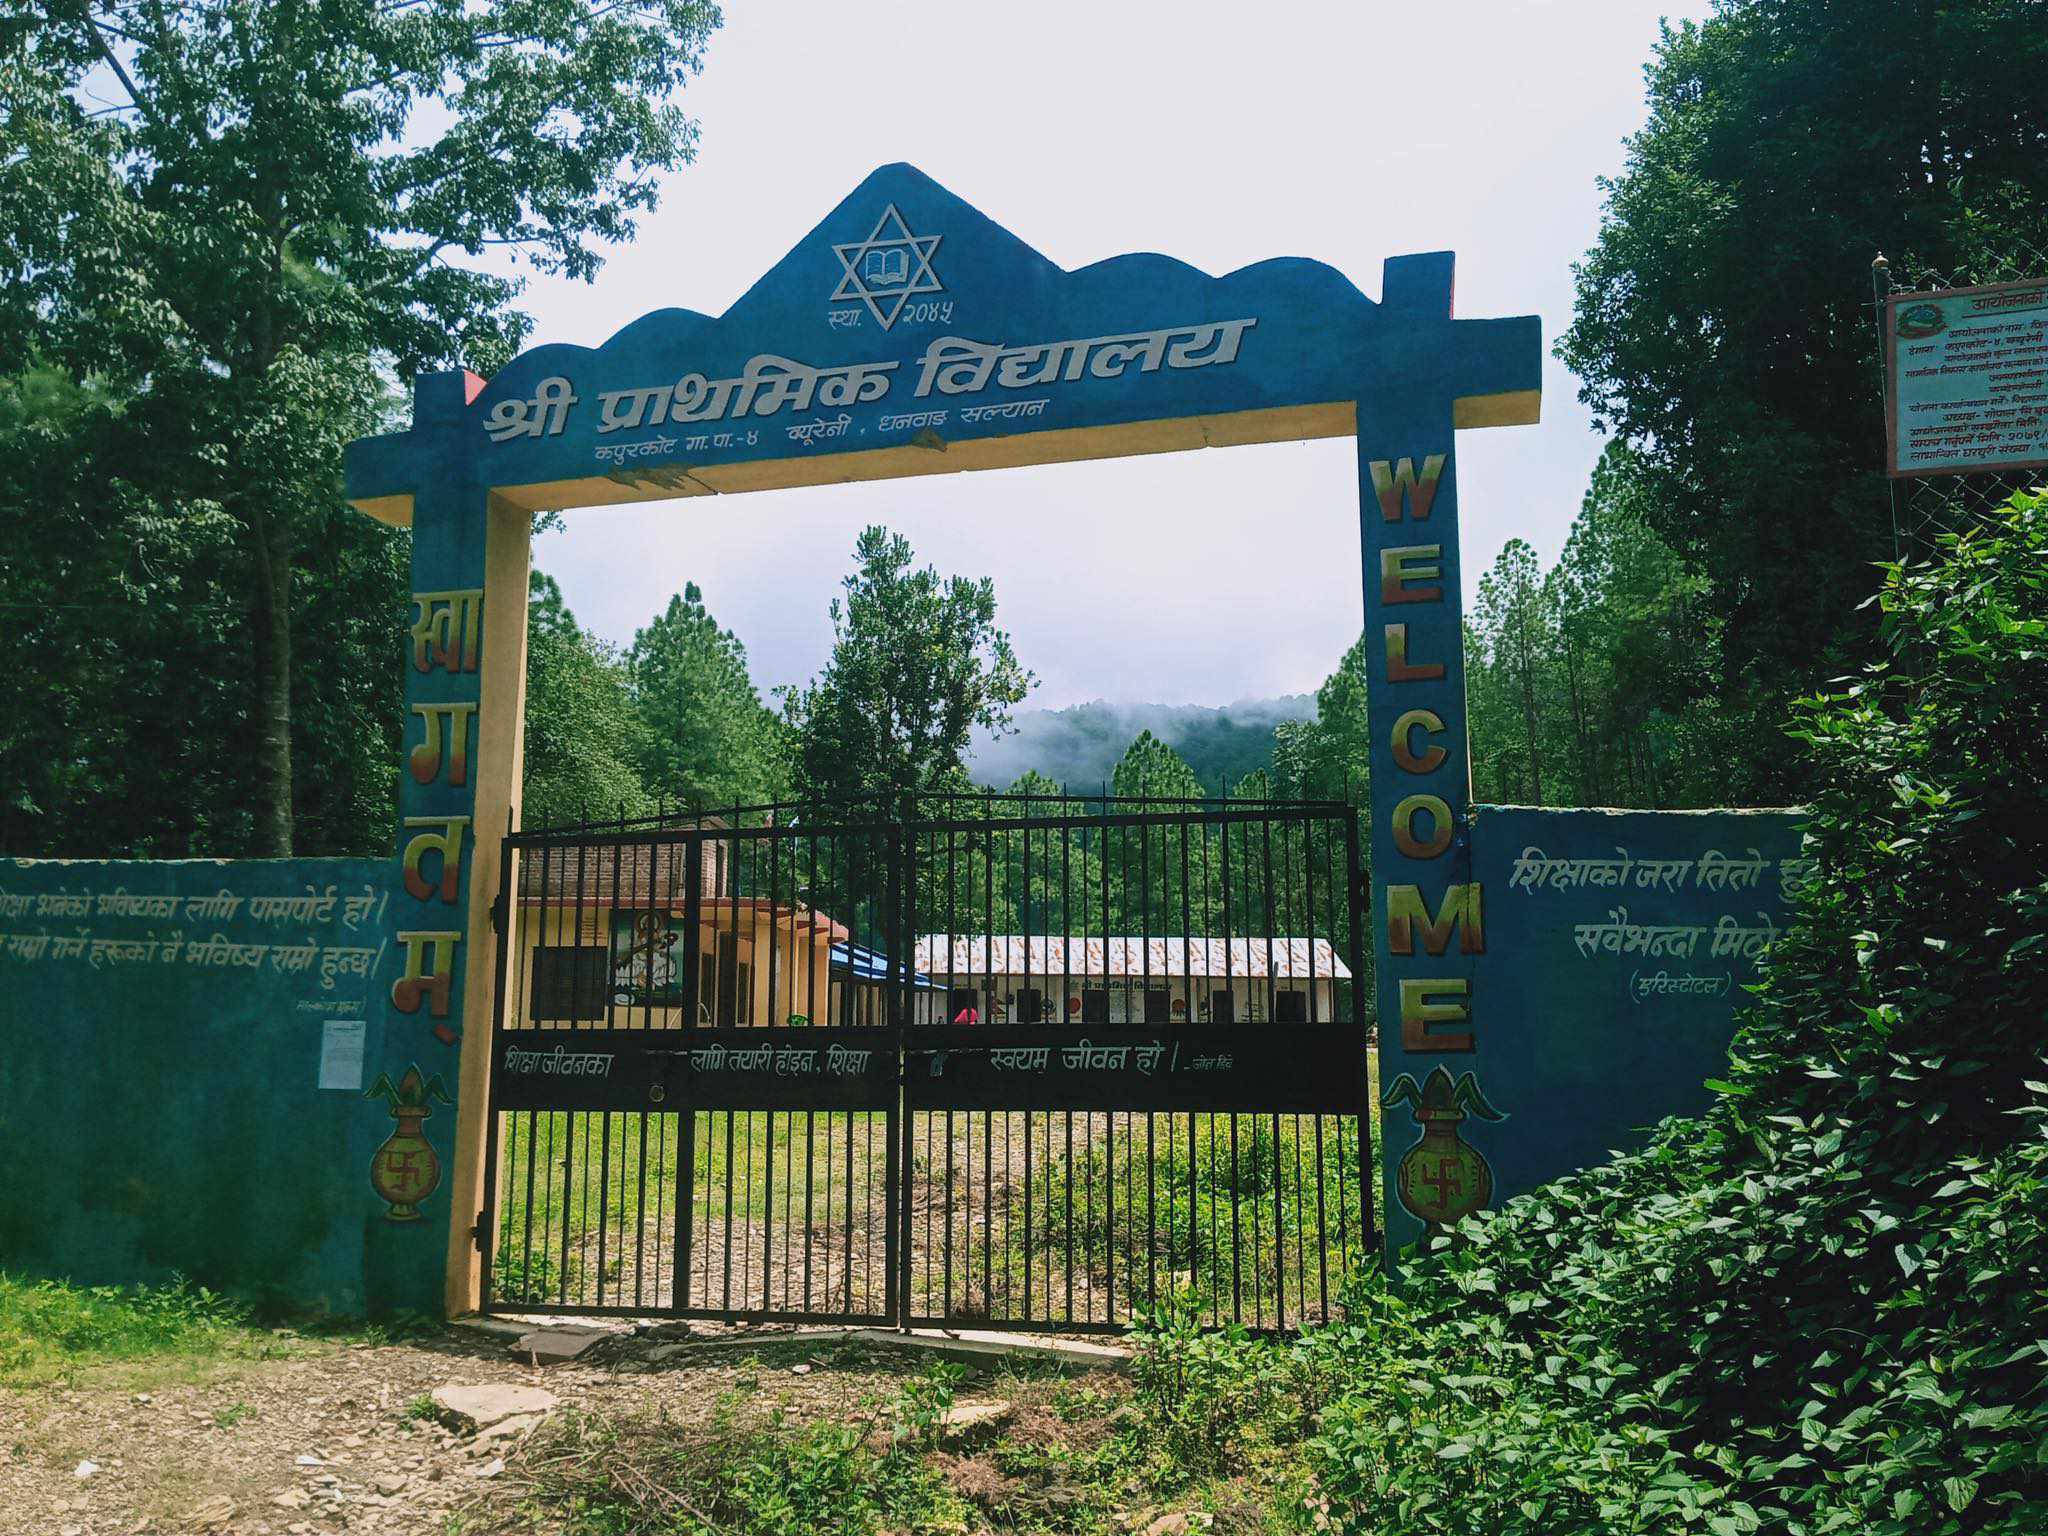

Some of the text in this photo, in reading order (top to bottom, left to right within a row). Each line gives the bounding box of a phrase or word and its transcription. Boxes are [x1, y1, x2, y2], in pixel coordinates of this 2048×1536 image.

[483, 318, 1258, 443] श्री प्राथमिक विद्यालय
[594, 433, 679, 466] कपुरकोट
[960, 398, 1051, 423] सल्यान
[1369, 453, 1485, 1052] WELCOME
[1508, 846, 1635, 896] शिक्षाको
[1636, 858, 1695, 894] जरा
[1696, 847, 1771, 893] तितो
[185, 888, 245, 923] लागि
[185, 932, 269, 968] भविष्य
[504, 1044, 540, 1075] शिक्षा
[541, 1044, 616, 1078] जीवनका
[689, 1042, 727, 1073] लागि
[728, 1042, 774, 1073] तयारी
[826, 1042, 873, 1076] शिक्षा
[1061, 1037, 1131, 1071] जीवन
